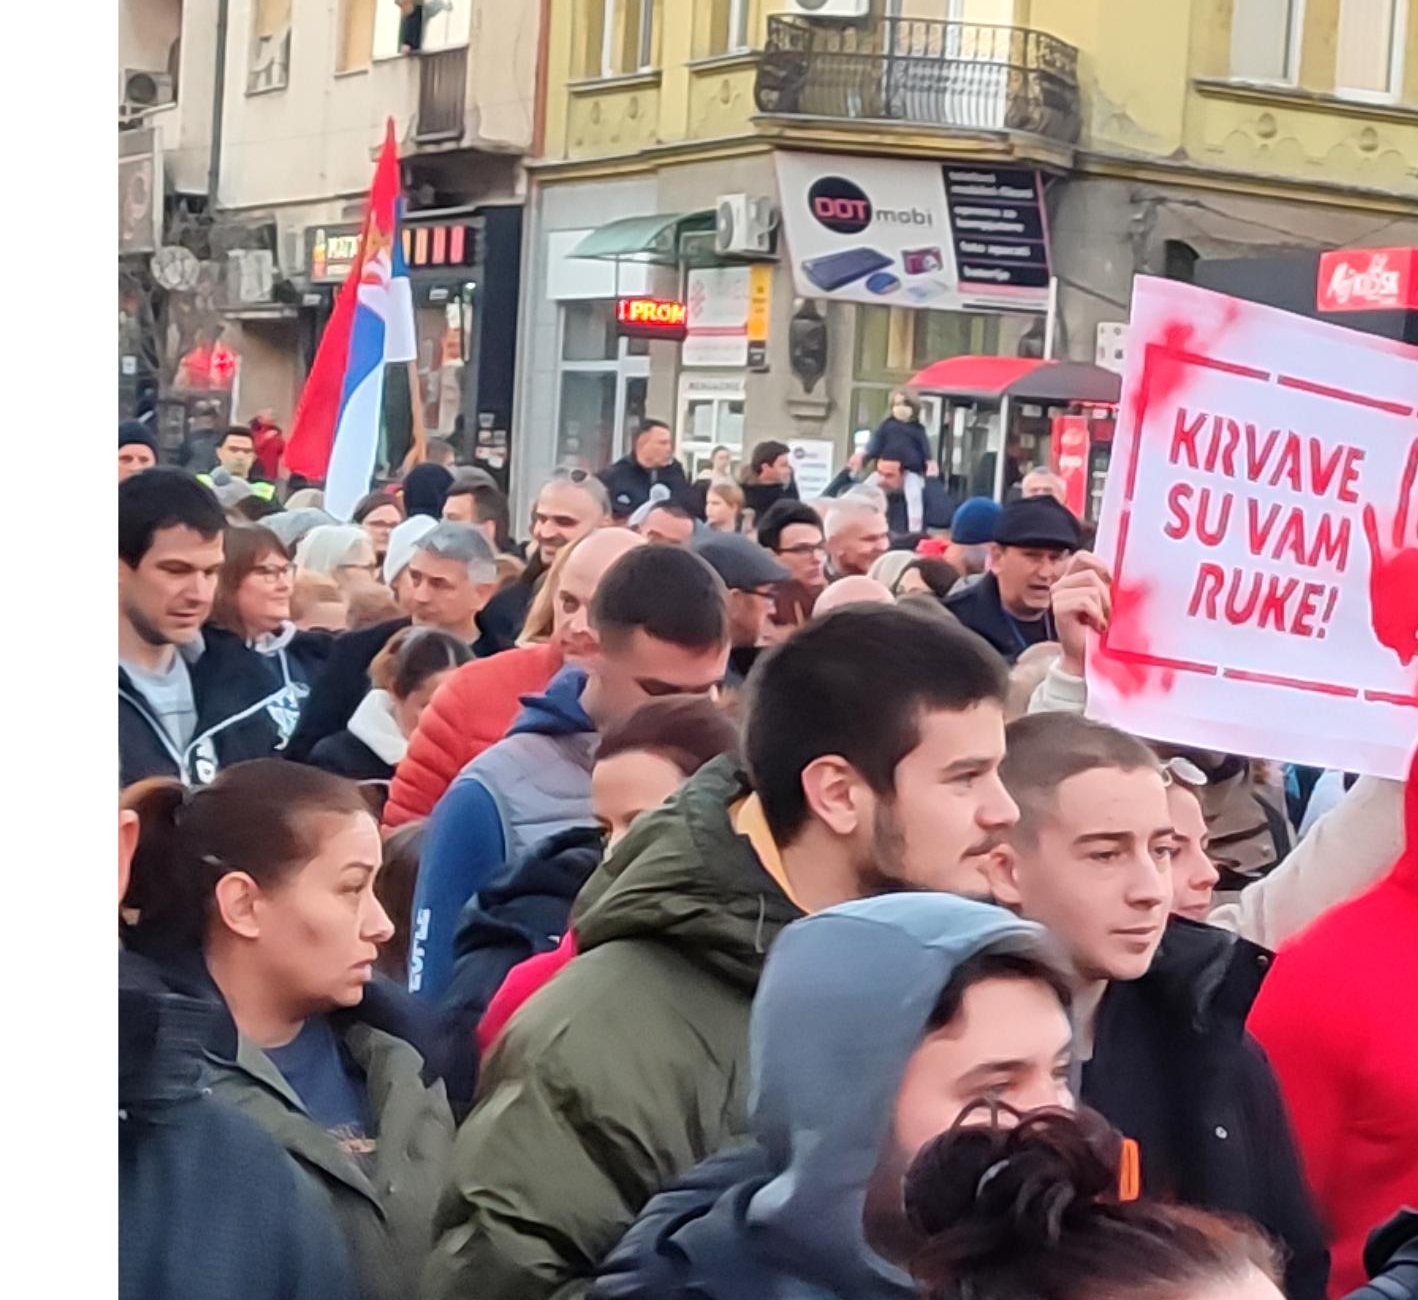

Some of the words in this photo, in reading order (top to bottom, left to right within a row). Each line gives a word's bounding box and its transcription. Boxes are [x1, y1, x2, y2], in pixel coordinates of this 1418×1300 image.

[814, 196, 868, 221] DOT
[876, 206, 934, 227] mobi
[1168, 407, 1366, 503] KRVAVE
[1163, 482, 1234, 546] SU
[1247, 497, 1351, 573] VAM
[1187, 562, 1339, 638] RUKE!
